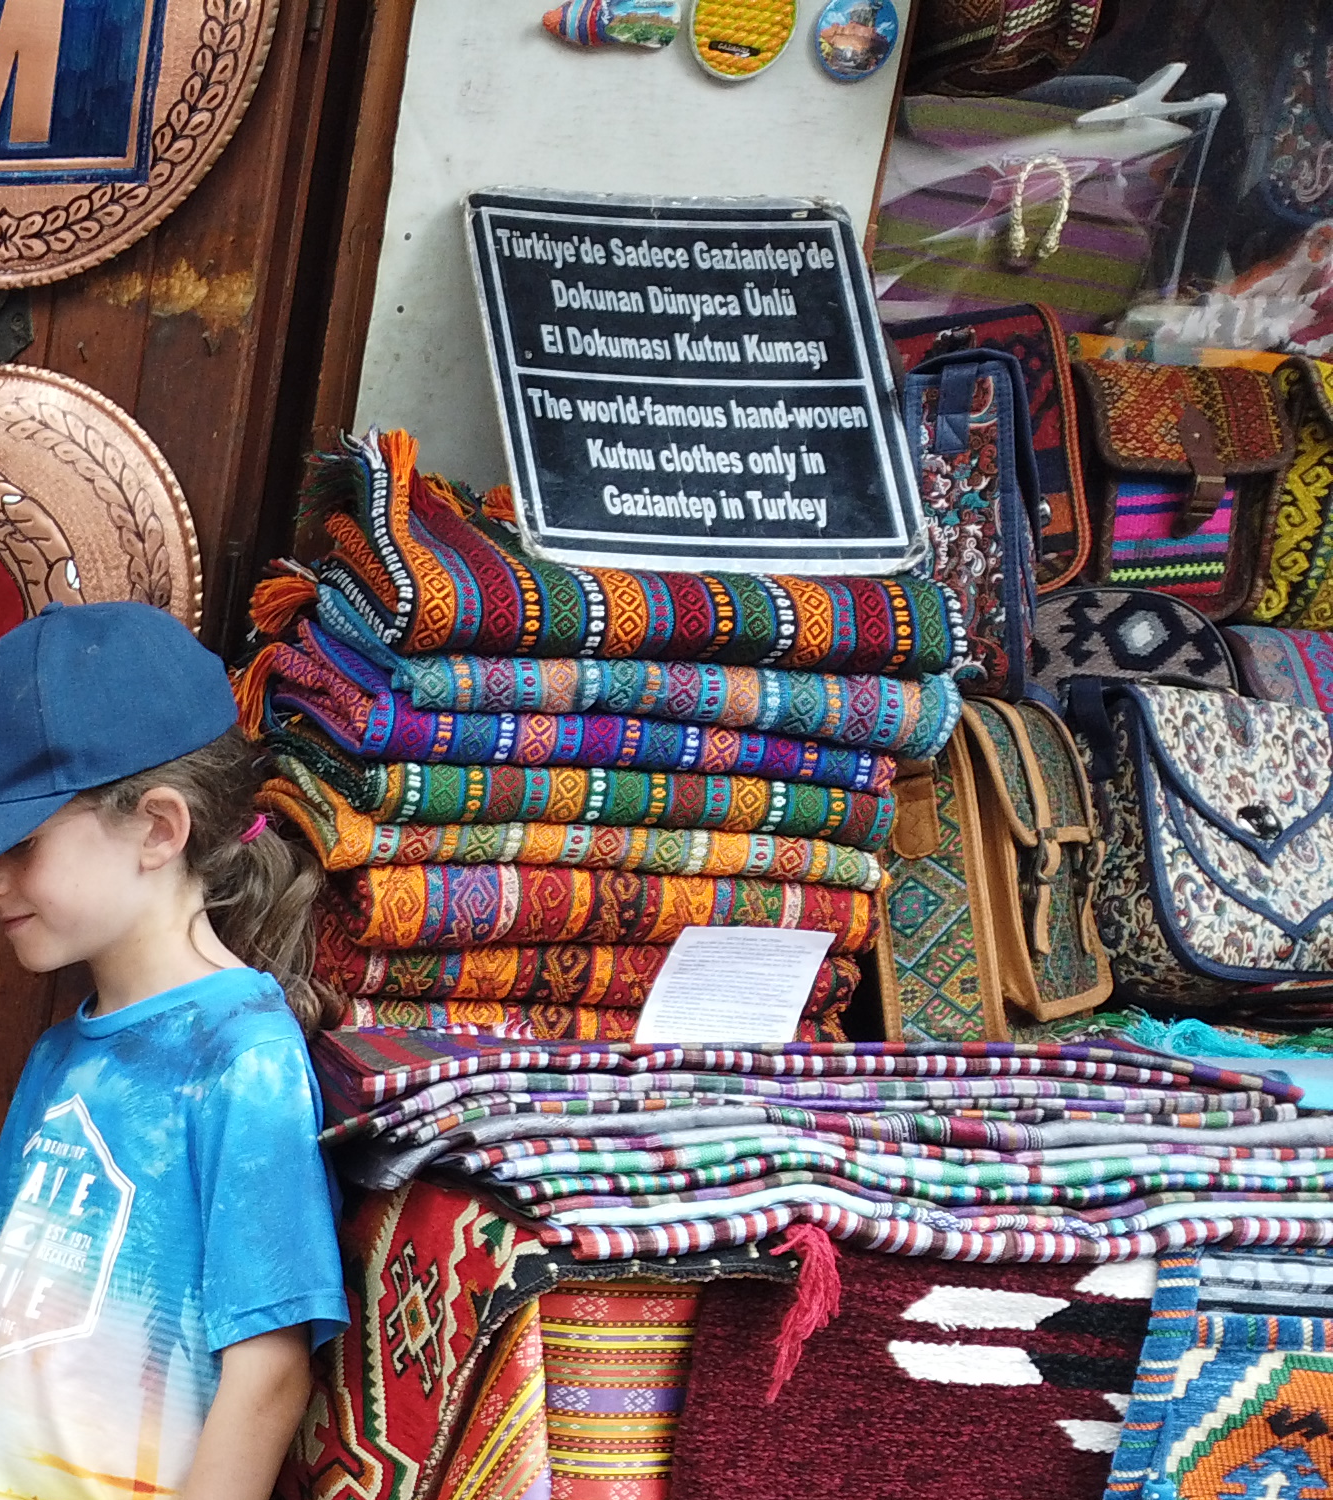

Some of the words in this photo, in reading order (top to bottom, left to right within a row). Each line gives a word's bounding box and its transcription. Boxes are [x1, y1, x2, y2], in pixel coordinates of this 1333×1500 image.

[496, 227, 607, 269] Türkiye'de
[611, 240, 691, 270] Sadece
[693, 241, 835, 277] Gaziantep'de
[551, 279, 644, 314] Dokunan
[648, 284, 741, 323] Dünyaca
[743, 281, 797, 316] Ünlü
[540, 323, 562, 355] El
[566, 327, 672, 361] Dokuması
[674, 331, 741, 363] Kutnu
[743, 334, 828, 370] Kumaşı
[526, 386, 574, 421] The
[578, 395, 727, 429] world-famous
[732, 399, 869, 430] hand-woven
[586, 437, 656, 472] Kutnu
[659, 443, 744, 475] clothes
[748, 445, 797, 483] only
[799, 445, 826, 475] in
[602, 485, 717, 526] Gaziantep
[720, 490, 745, 520] in
[746, 490, 828, 528] Turkey
[19, 1160, 97, 1217] AVE
